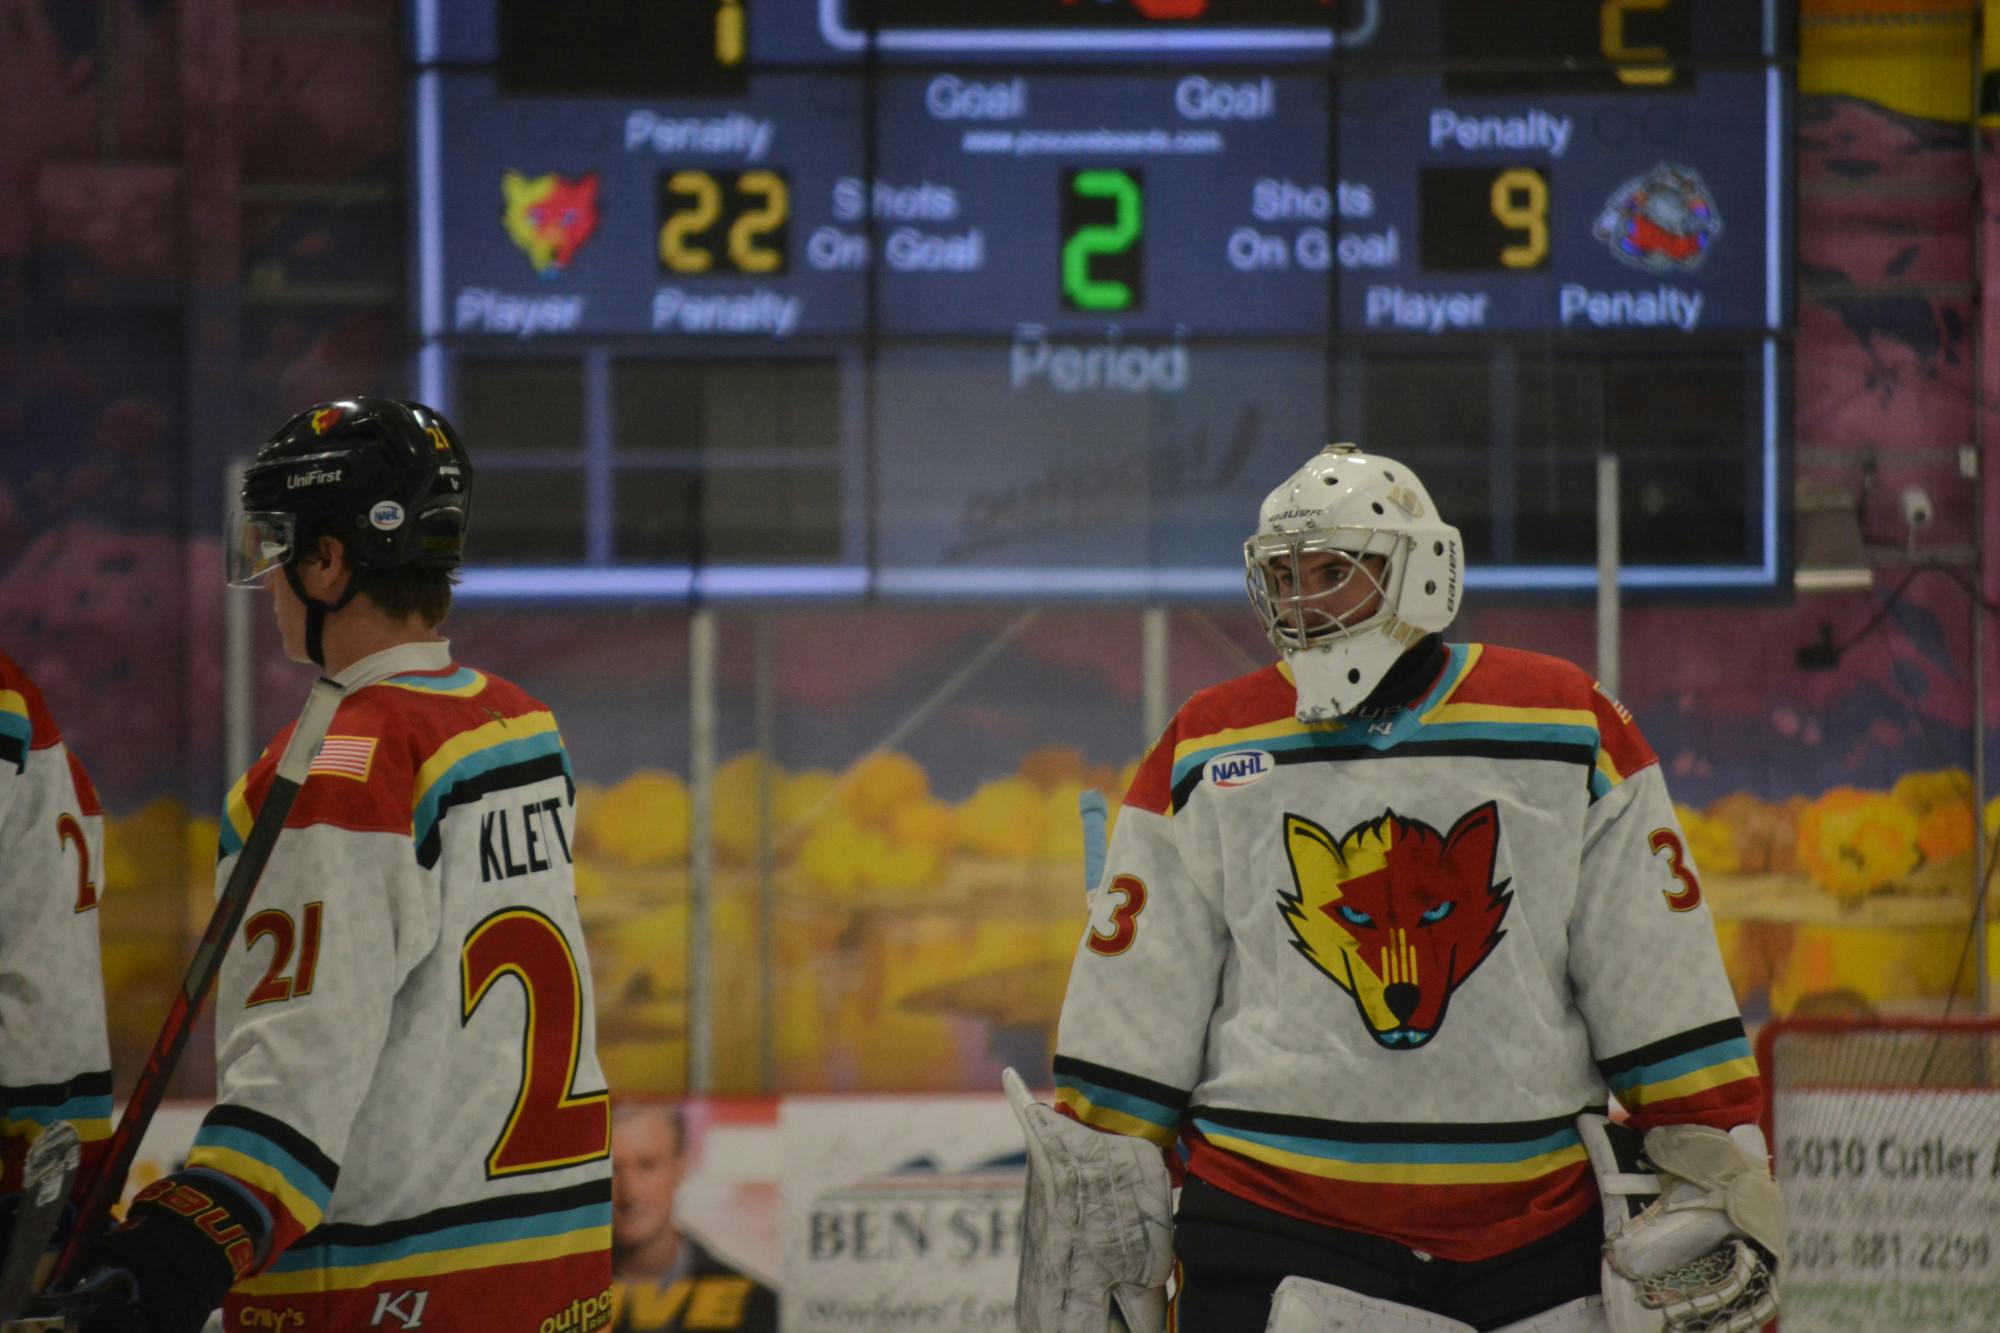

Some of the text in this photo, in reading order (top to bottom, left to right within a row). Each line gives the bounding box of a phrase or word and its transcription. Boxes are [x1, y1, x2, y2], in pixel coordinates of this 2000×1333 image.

[927, 73, 1027, 120] Goal
[1175, 73, 1275, 120] Goal
[625, 110, 775, 160] Penalty
[1429, 108, 1574, 157] Penalty
[659, 169, 791, 274] 22
[832, 178, 958, 221] Shots
[1252, 178, 1376, 221] Shots
[1490, 167, 1550, 271] 9
[807, 226, 985, 271] On Goal
[1062, 169, 1143, 311] 2
[1228, 226, 1399, 271] On Goal
[455, 287, 584, 338] Player
[652, 287, 801, 337] Penalty
[1365, 286, 1488, 333] Player
[1560, 284, 1702, 332] Penalty
[1010, 325, 1190, 392] Period
[286, 468, 343, 490] UniFirst
[374, 509, 401, 523] NAHL
[1210, 750, 1269, 785] NAHL
[57, 811, 98, 914] 2
[479, 797, 573, 883] KLET
[1648, 827, 1702, 912] 3
[1086, 873, 1147, 957] 3
[244, 901, 324, 1009] 21
[461, 905, 612, 1181] 2
[1876, 1135, 1979, 1179] Cutler
[809, 1209, 932, 1261] BEN
[370, 1290, 429, 1329] K1
